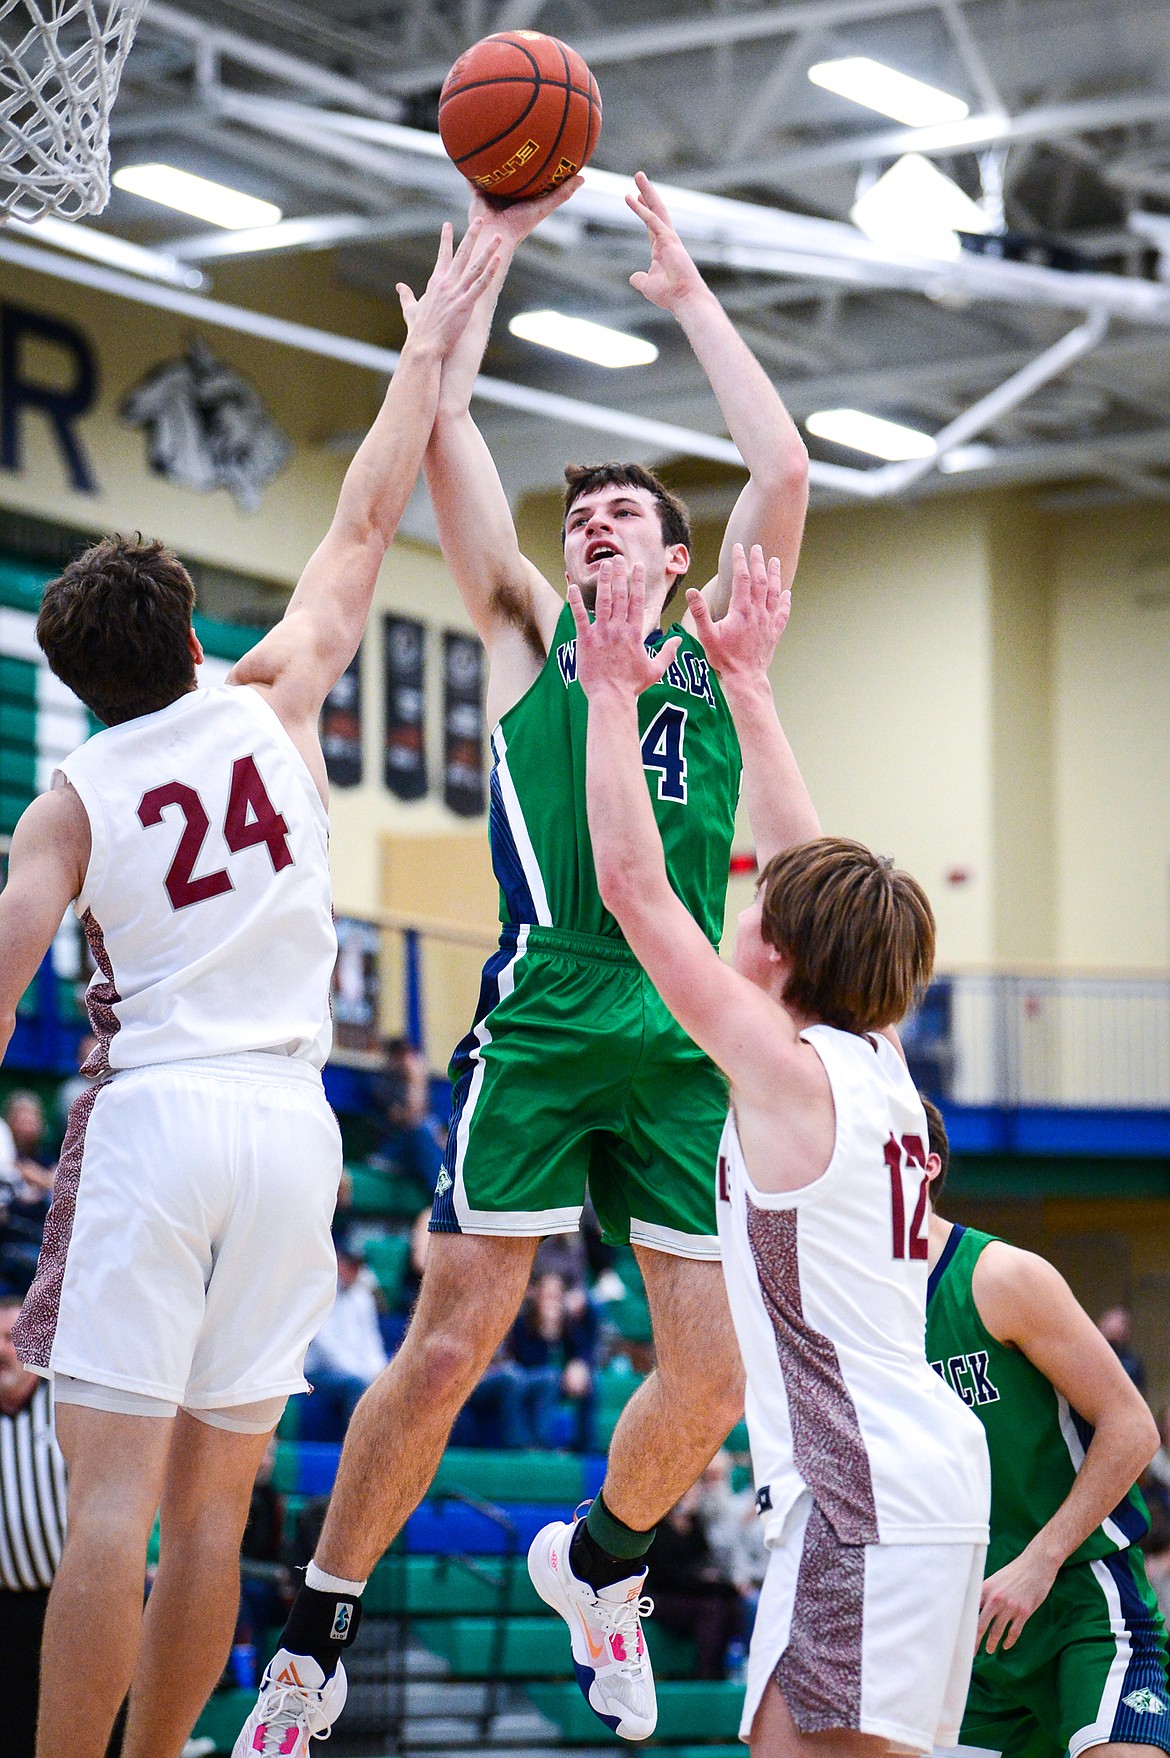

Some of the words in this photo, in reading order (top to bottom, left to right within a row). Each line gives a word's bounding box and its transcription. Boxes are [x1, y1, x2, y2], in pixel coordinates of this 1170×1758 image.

[0, 303, 101, 496] R
[135, 752, 296, 913] 24
[883, 1129, 929, 1262] 12
